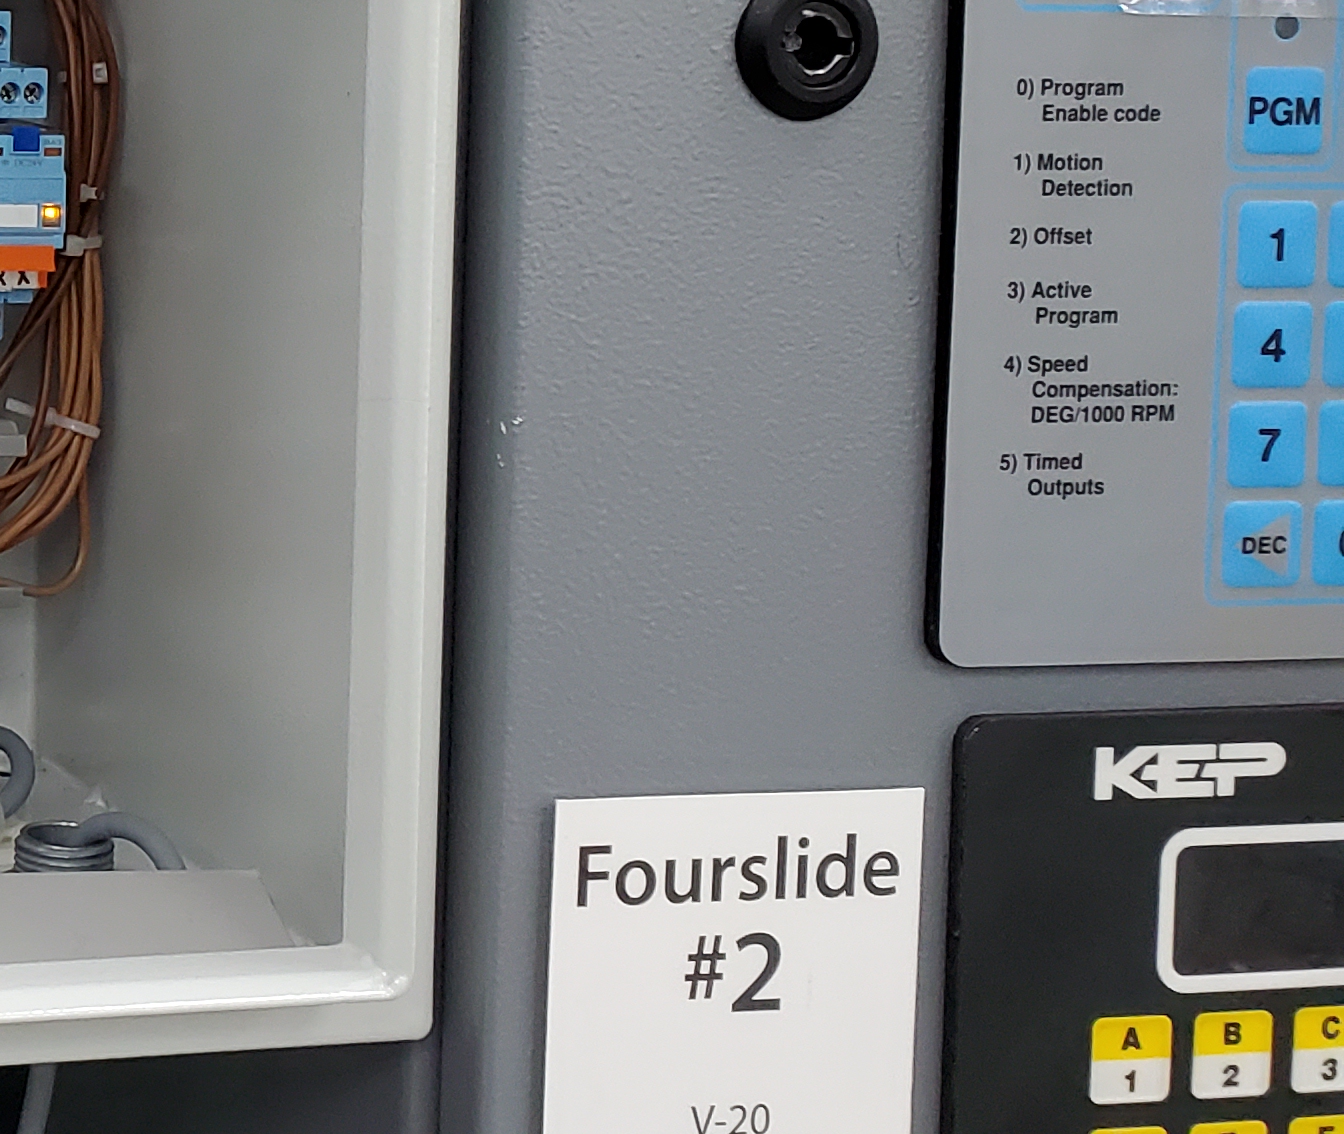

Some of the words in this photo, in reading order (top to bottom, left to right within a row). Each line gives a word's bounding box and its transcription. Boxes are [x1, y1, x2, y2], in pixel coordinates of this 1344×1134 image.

[1016, 78, 1035, 100] 0)
[1040, 79, 1125, 101] Program
[1042, 104, 1108, 123] Enable
[1113, 104, 1161, 123] code
[1247, 96, 1322, 126] PGM
[1013, 154, 1031, 175] 1)
[1037, 153, 1103, 171] Motion
[1042, 178, 1133, 197] Detection
[1009, 227, 1027, 248] 2)
[1033, 227, 1093, 246] Offset
[1269, 227, 1285, 262] 1
[1007, 281, 1025, 303] 3)
[1031, 280, 1093, 299] Active
[1035, 307, 1119, 328] Program
[1260, 328, 1287, 363] 4
[1003, 356, 1022, 377] 4)
[1027, 355, 1089, 376] Speed
[1032, 379, 1179, 402] Compensation:
[1030, 405, 1126, 424] DEG/1000
[1131, 404, 1176, 423] RPM
[1257, 427, 1282, 463] 7
[999, 454, 1017, 475] 5)
[1023, 452, 1084, 471] Timed
[1027, 478, 1105, 501] Outputs
[1240, 535, 1288, 556] DEC
[1094, 741, 1287, 802] KEP
[575, 833, 901, 909] Fourslide
[684, 930, 783, 1013] #2
[1122, 1027, 1142, 1051] A
[1224, 1022, 1242, 1045] B
[1322, 1016, 1340, 1040] C
[1124, 1069, 1137, 1092] 1
[1222, 1064, 1240, 1088] 2
[1322, 1058, 1339, 1081] 3
[690, 1103, 771, 1134] V-20
